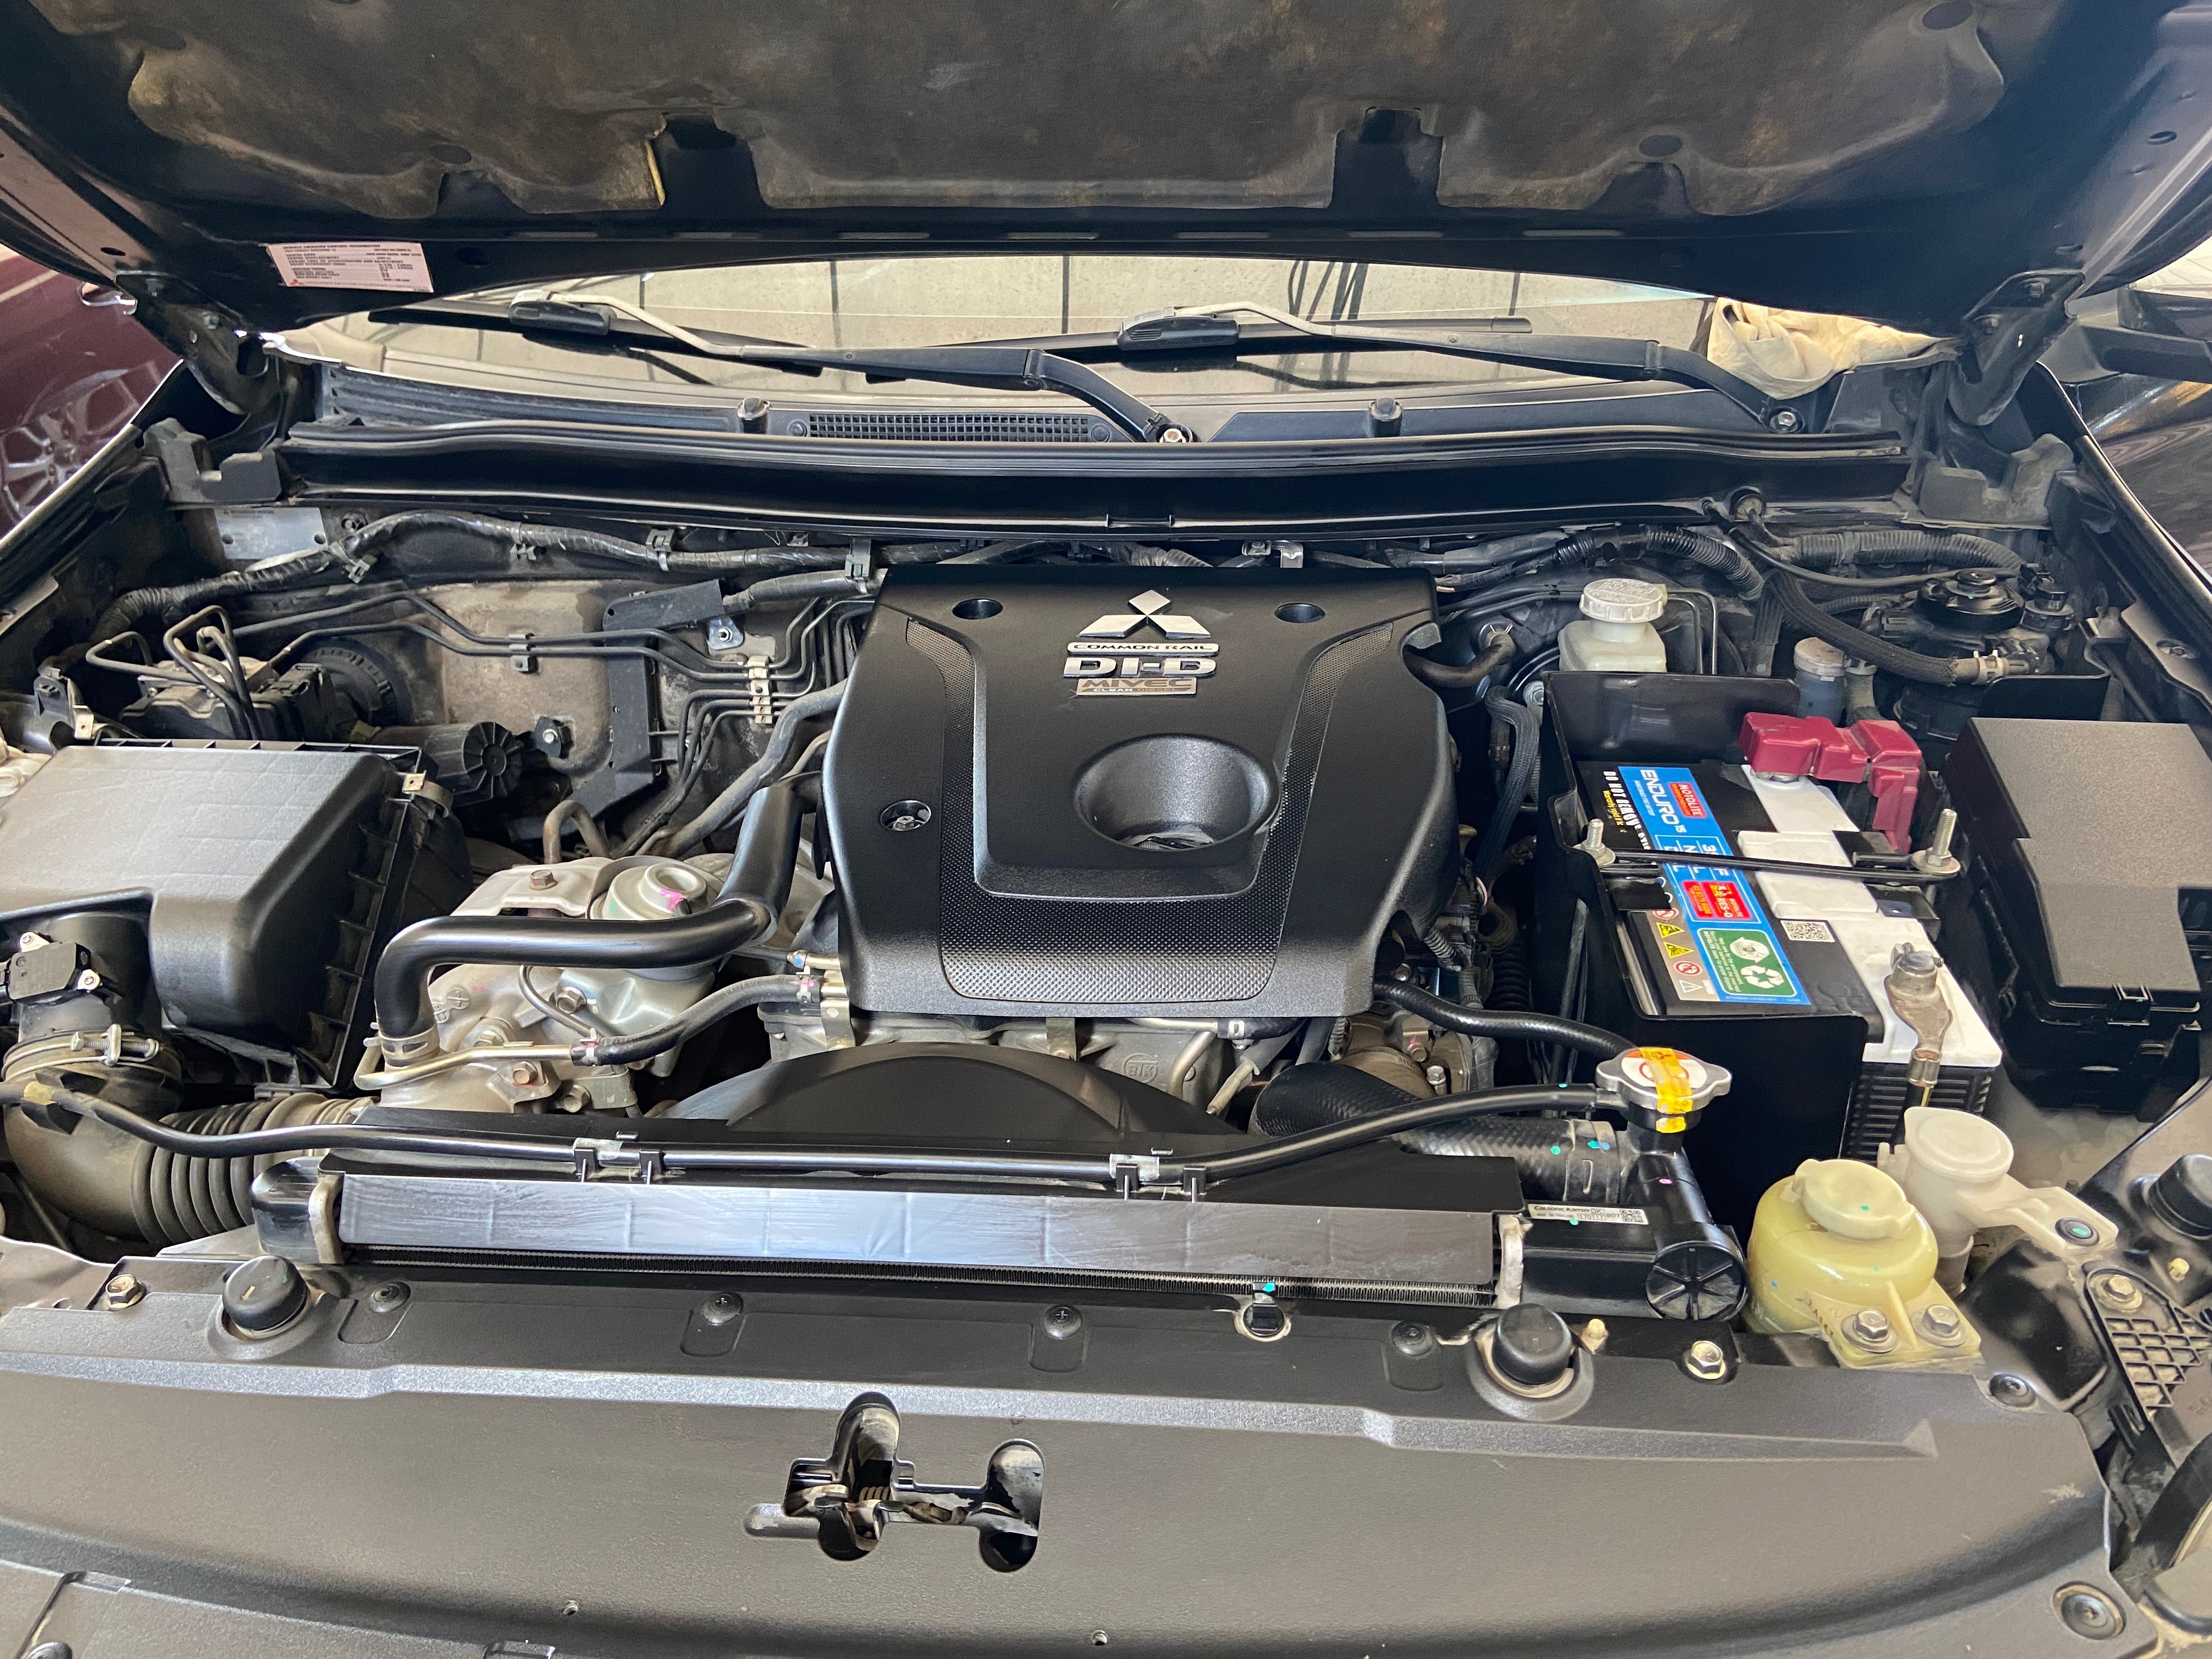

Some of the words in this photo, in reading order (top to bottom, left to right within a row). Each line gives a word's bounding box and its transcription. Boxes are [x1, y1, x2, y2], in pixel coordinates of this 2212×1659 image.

[1063, 657, 1217, 678] DI-D
[1082, 679, 1192, 687] MIVEC
[1603, 771, 1619, 781] DO
[1608, 783, 1627, 798] NOT
[1640, 769, 1680, 825] ENDURO
[1674, 824, 1687, 833] 15
[1678, 784, 1702, 816] MOTOLITE
[1602, 790, 1615, 809] Warranty
[1610, 808, 1621, 817] void
[1683, 845, 1706, 873] NL
[1703, 844, 1730, 876] 3F
[1716, 897, 1734, 918] RES-Q
[1729, 899, 1743, 917] MOTOLITE
[1703, 930, 1716, 949] MOTOLITE
[1126, 1060, 1158, 1076] BTK
